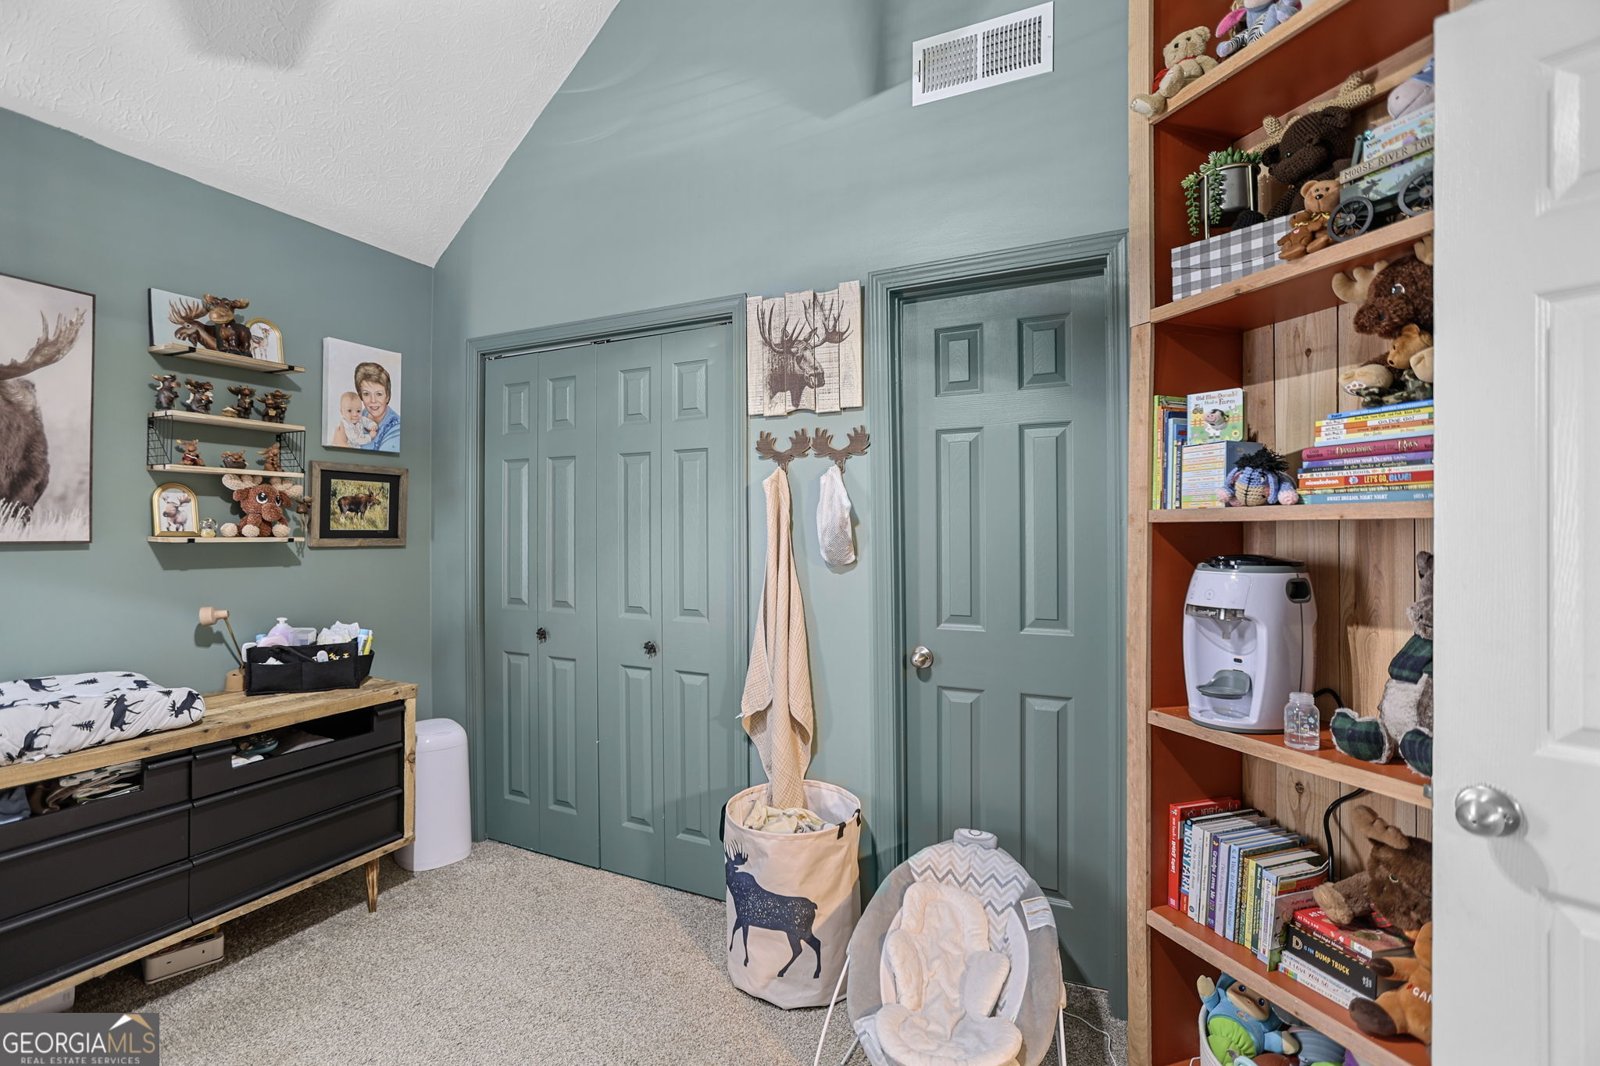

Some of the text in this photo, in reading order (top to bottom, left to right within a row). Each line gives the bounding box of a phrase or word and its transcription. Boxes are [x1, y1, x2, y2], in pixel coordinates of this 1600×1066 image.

[1344, 162, 1374, 179] MOOSE
[1378, 147, 1409, 166] RIVER
[1412, 134, 1434, 151] TOU
[1364, 476, 1378, 484] LET'S
[1378, 475, 1388, 484] GO,
[1184, 828, 1193, 862] NOISY
[1182, 863, 1191, 892] FARM
[1292, 935, 1302, 950] D
[1315, 950, 1331, 964] DUMP
[1332, 959, 1350, 976] TRUCK
